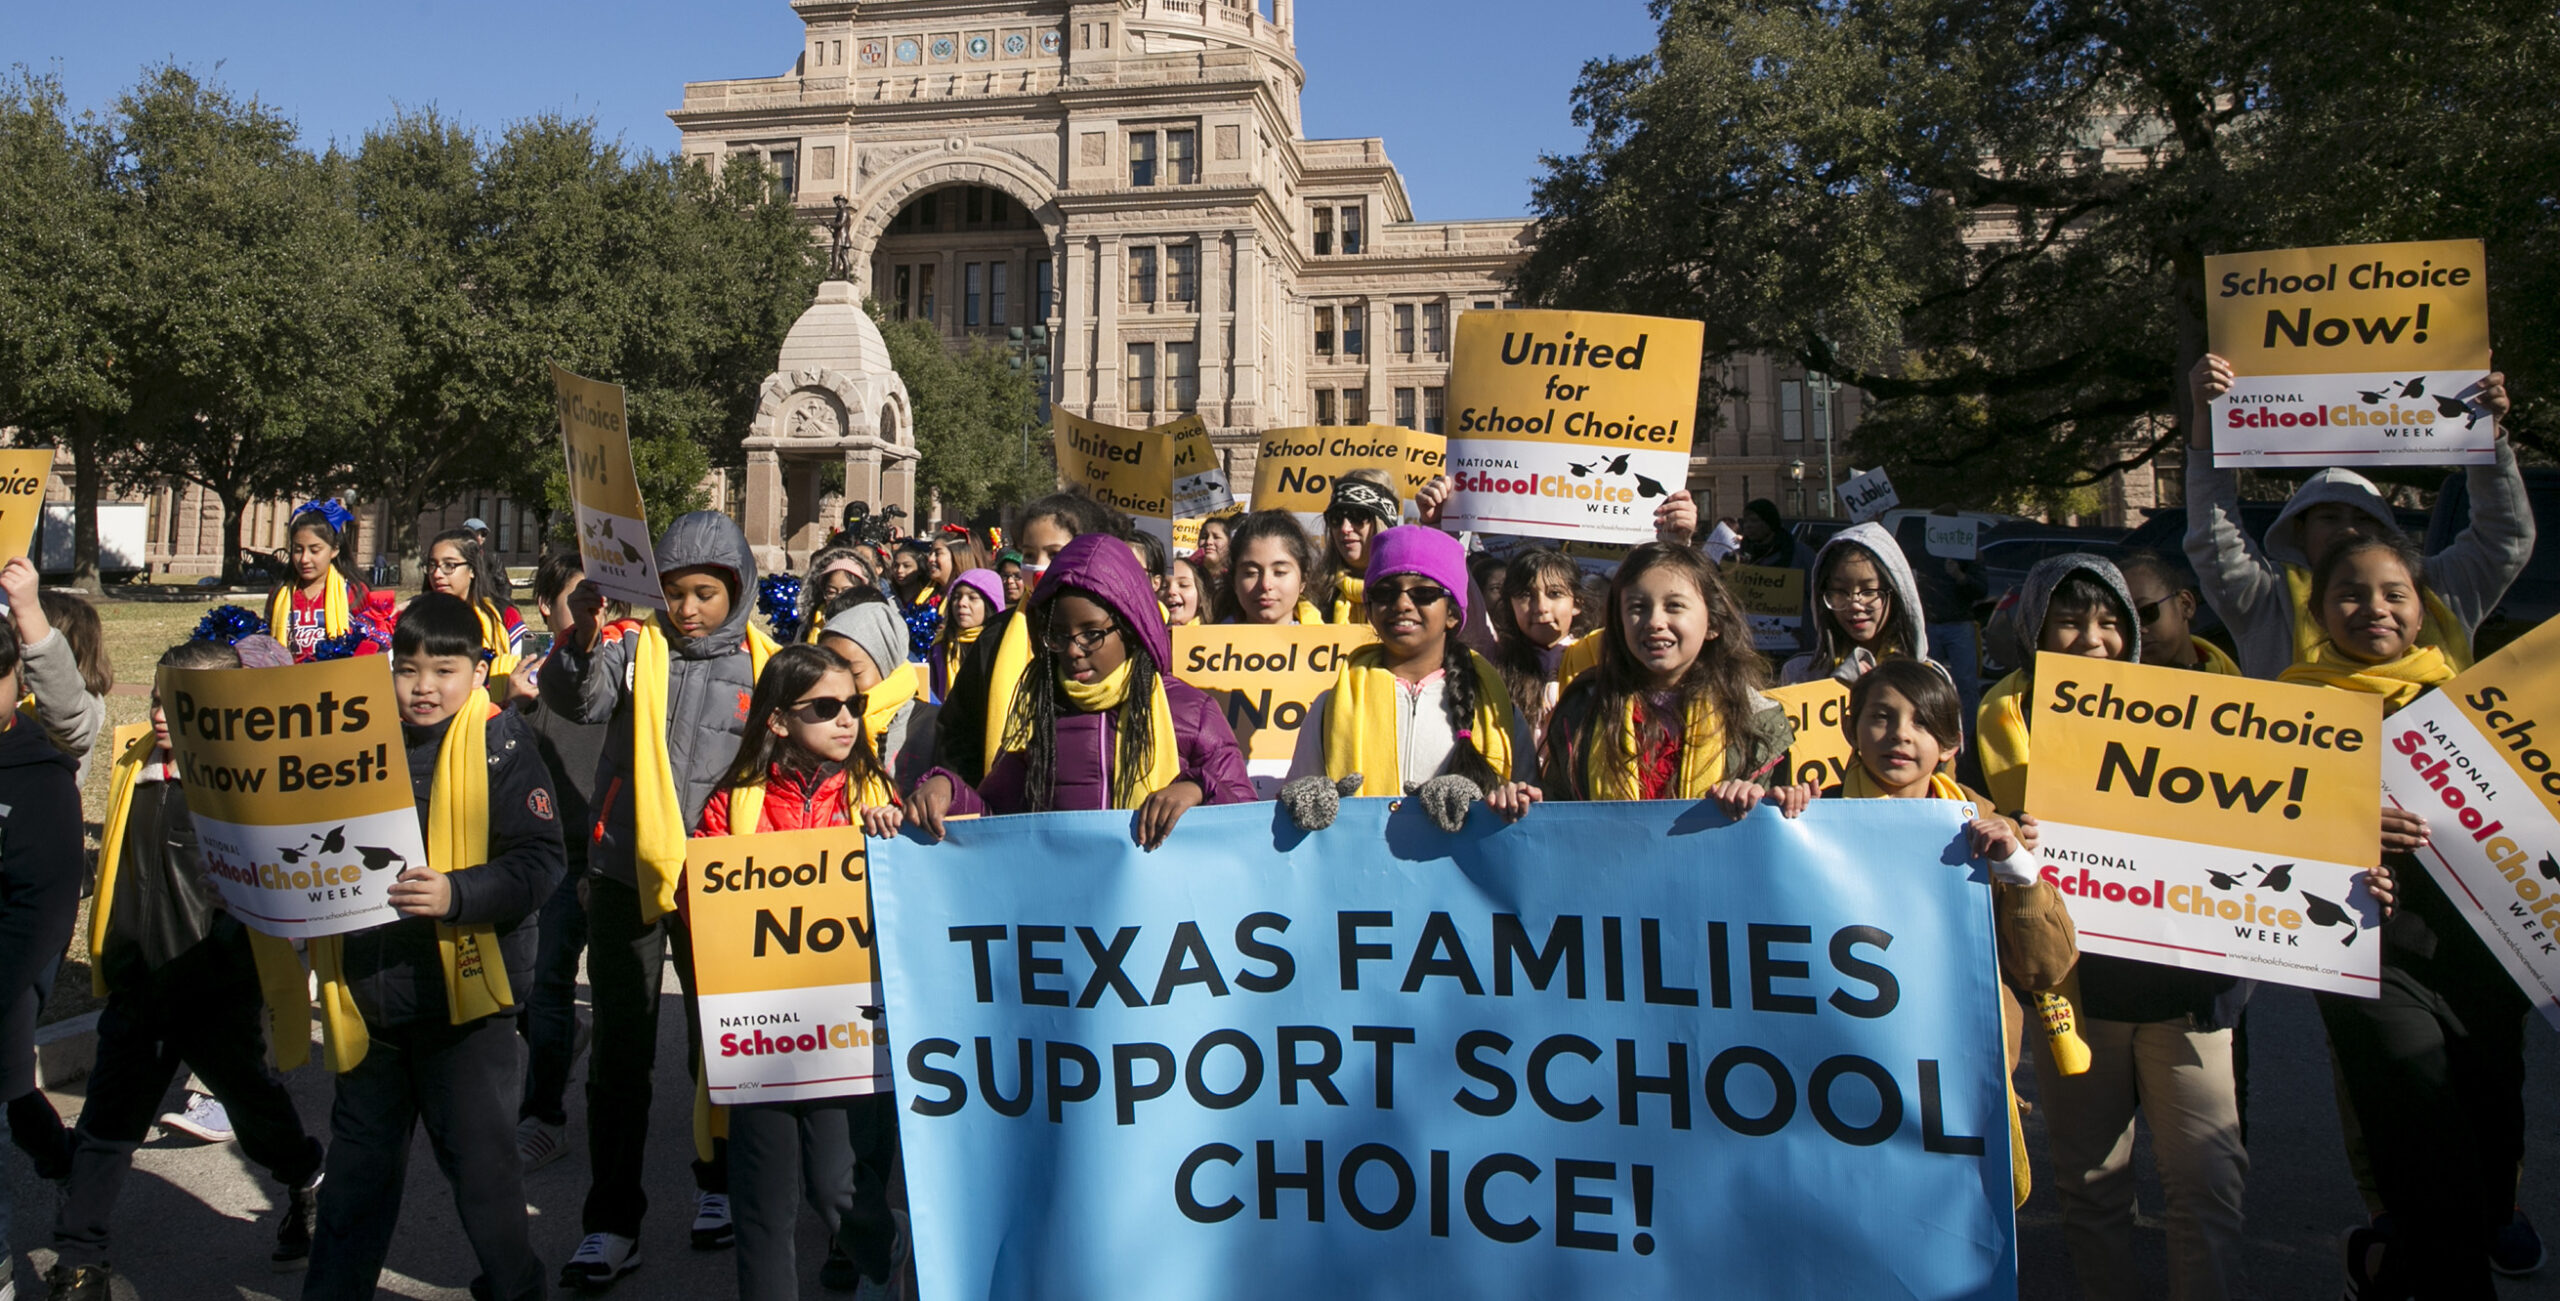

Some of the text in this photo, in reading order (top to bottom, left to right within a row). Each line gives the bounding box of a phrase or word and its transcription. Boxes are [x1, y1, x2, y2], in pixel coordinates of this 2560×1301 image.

[2220, 259, 2471, 298] School Choice
[2263, 303, 2431, 348] Now!
[1501, 331, 1648, 370] United
[1545, 374, 1591, 401] for
[2229, 393, 2304, 404] NATIONAL
[572, 394, 620, 433] Choice
[1458, 407, 1679, 444] School Choice!
[2227, 403, 2436, 429] SchoolChoice
[1067, 425, 1143, 465] United
[1263, 437, 1326, 458] School
[1330, 437, 1398, 458] Choice
[2384, 427, 2435, 438] WEEK
[1085, 461, 1110, 481] for
[1456, 458, 1519, 469] NATIONAL
[1278, 466, 1337, 494] No
[1454, 471, 1633, 503] SchoolChoice
[1096, 488, 1166, 513] Choice!
[1586, 503, 1630, 515] WEEK
[1735, 570, 1786, 588] United
[1186, 643, 1298, 673] School
[175, 690, 371, 742] Parents
[2050, 680, 2364, 752] School Choice
[184, 743, 388, 793] Know Best!
[2423, 720, 2499, 802] NATIONAL
[2095, 740, 2310, 820] Now!
[702, 849, 829, 894] School
[2043, 847, 2138, 872] NATIONAL
[308, 885, 363, 903] WEEK
[2234, 925, 2299, 947] WEEK
[2508, 901, 2557, 956] WEEK
[948, 910, 1901, 1019] TEXAS FAMILIES
[2228, 951, 2339, 977] www.schoolchoiceweek.com
[720, 1012, 801, 1028] NATIONAL
[738, 1082, 760, 1090] #SCW
[906, 1025, 1986, 1157] SUPPORT SCHOOL
[1174, 1140, 1656, 1256] CHOICE!
